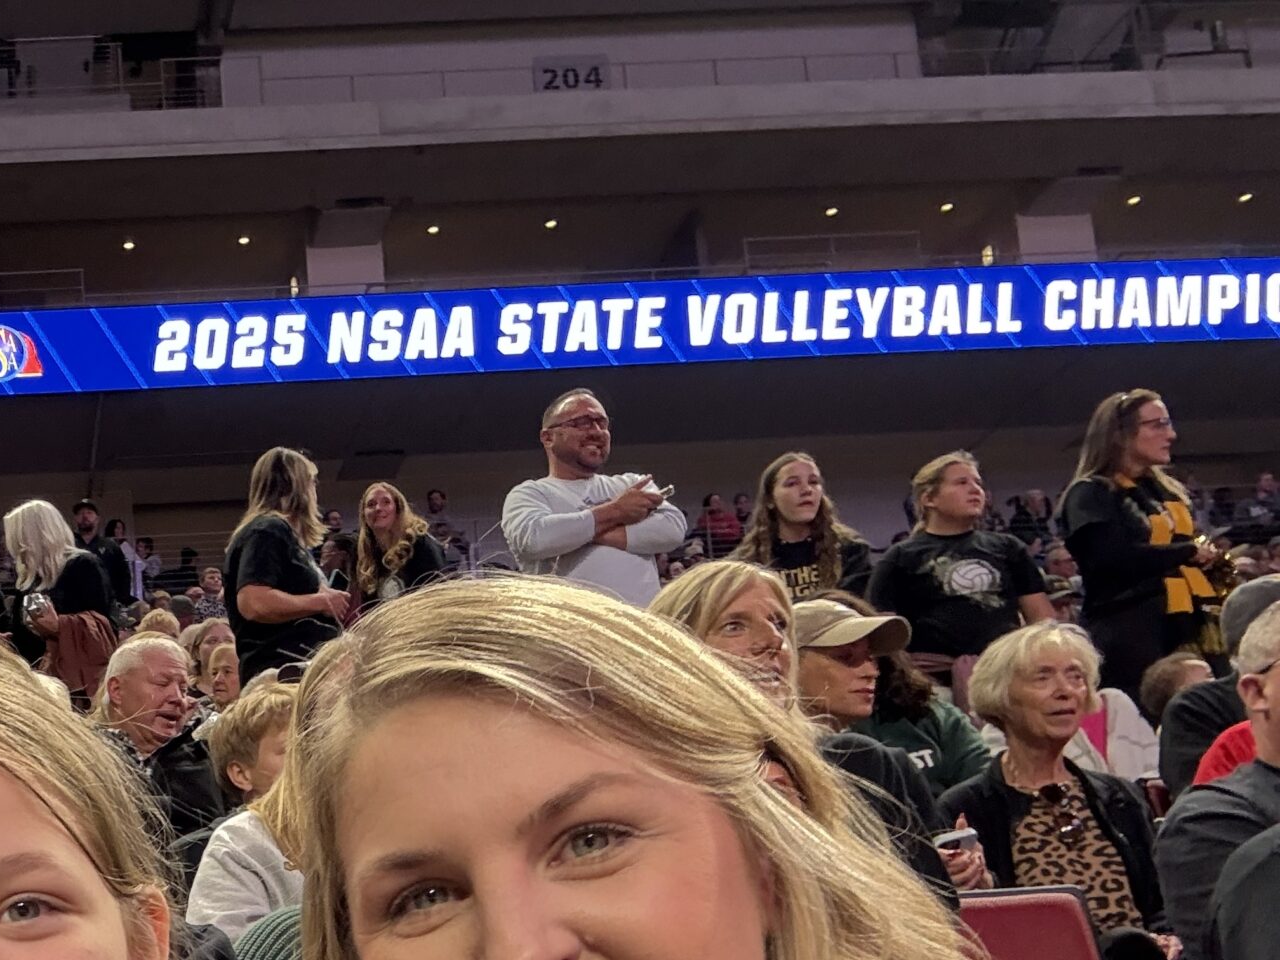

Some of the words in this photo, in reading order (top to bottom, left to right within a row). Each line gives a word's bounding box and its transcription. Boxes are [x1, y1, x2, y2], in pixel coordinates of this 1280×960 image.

[542, 66, 603, 90] 204
[153, 313, 308, 373] 2025
[326, 305, 475, 364] NSAA
[496, 296, 667, 356] STATE
[686, 281, 1023, 347] VOLLEYBALL
